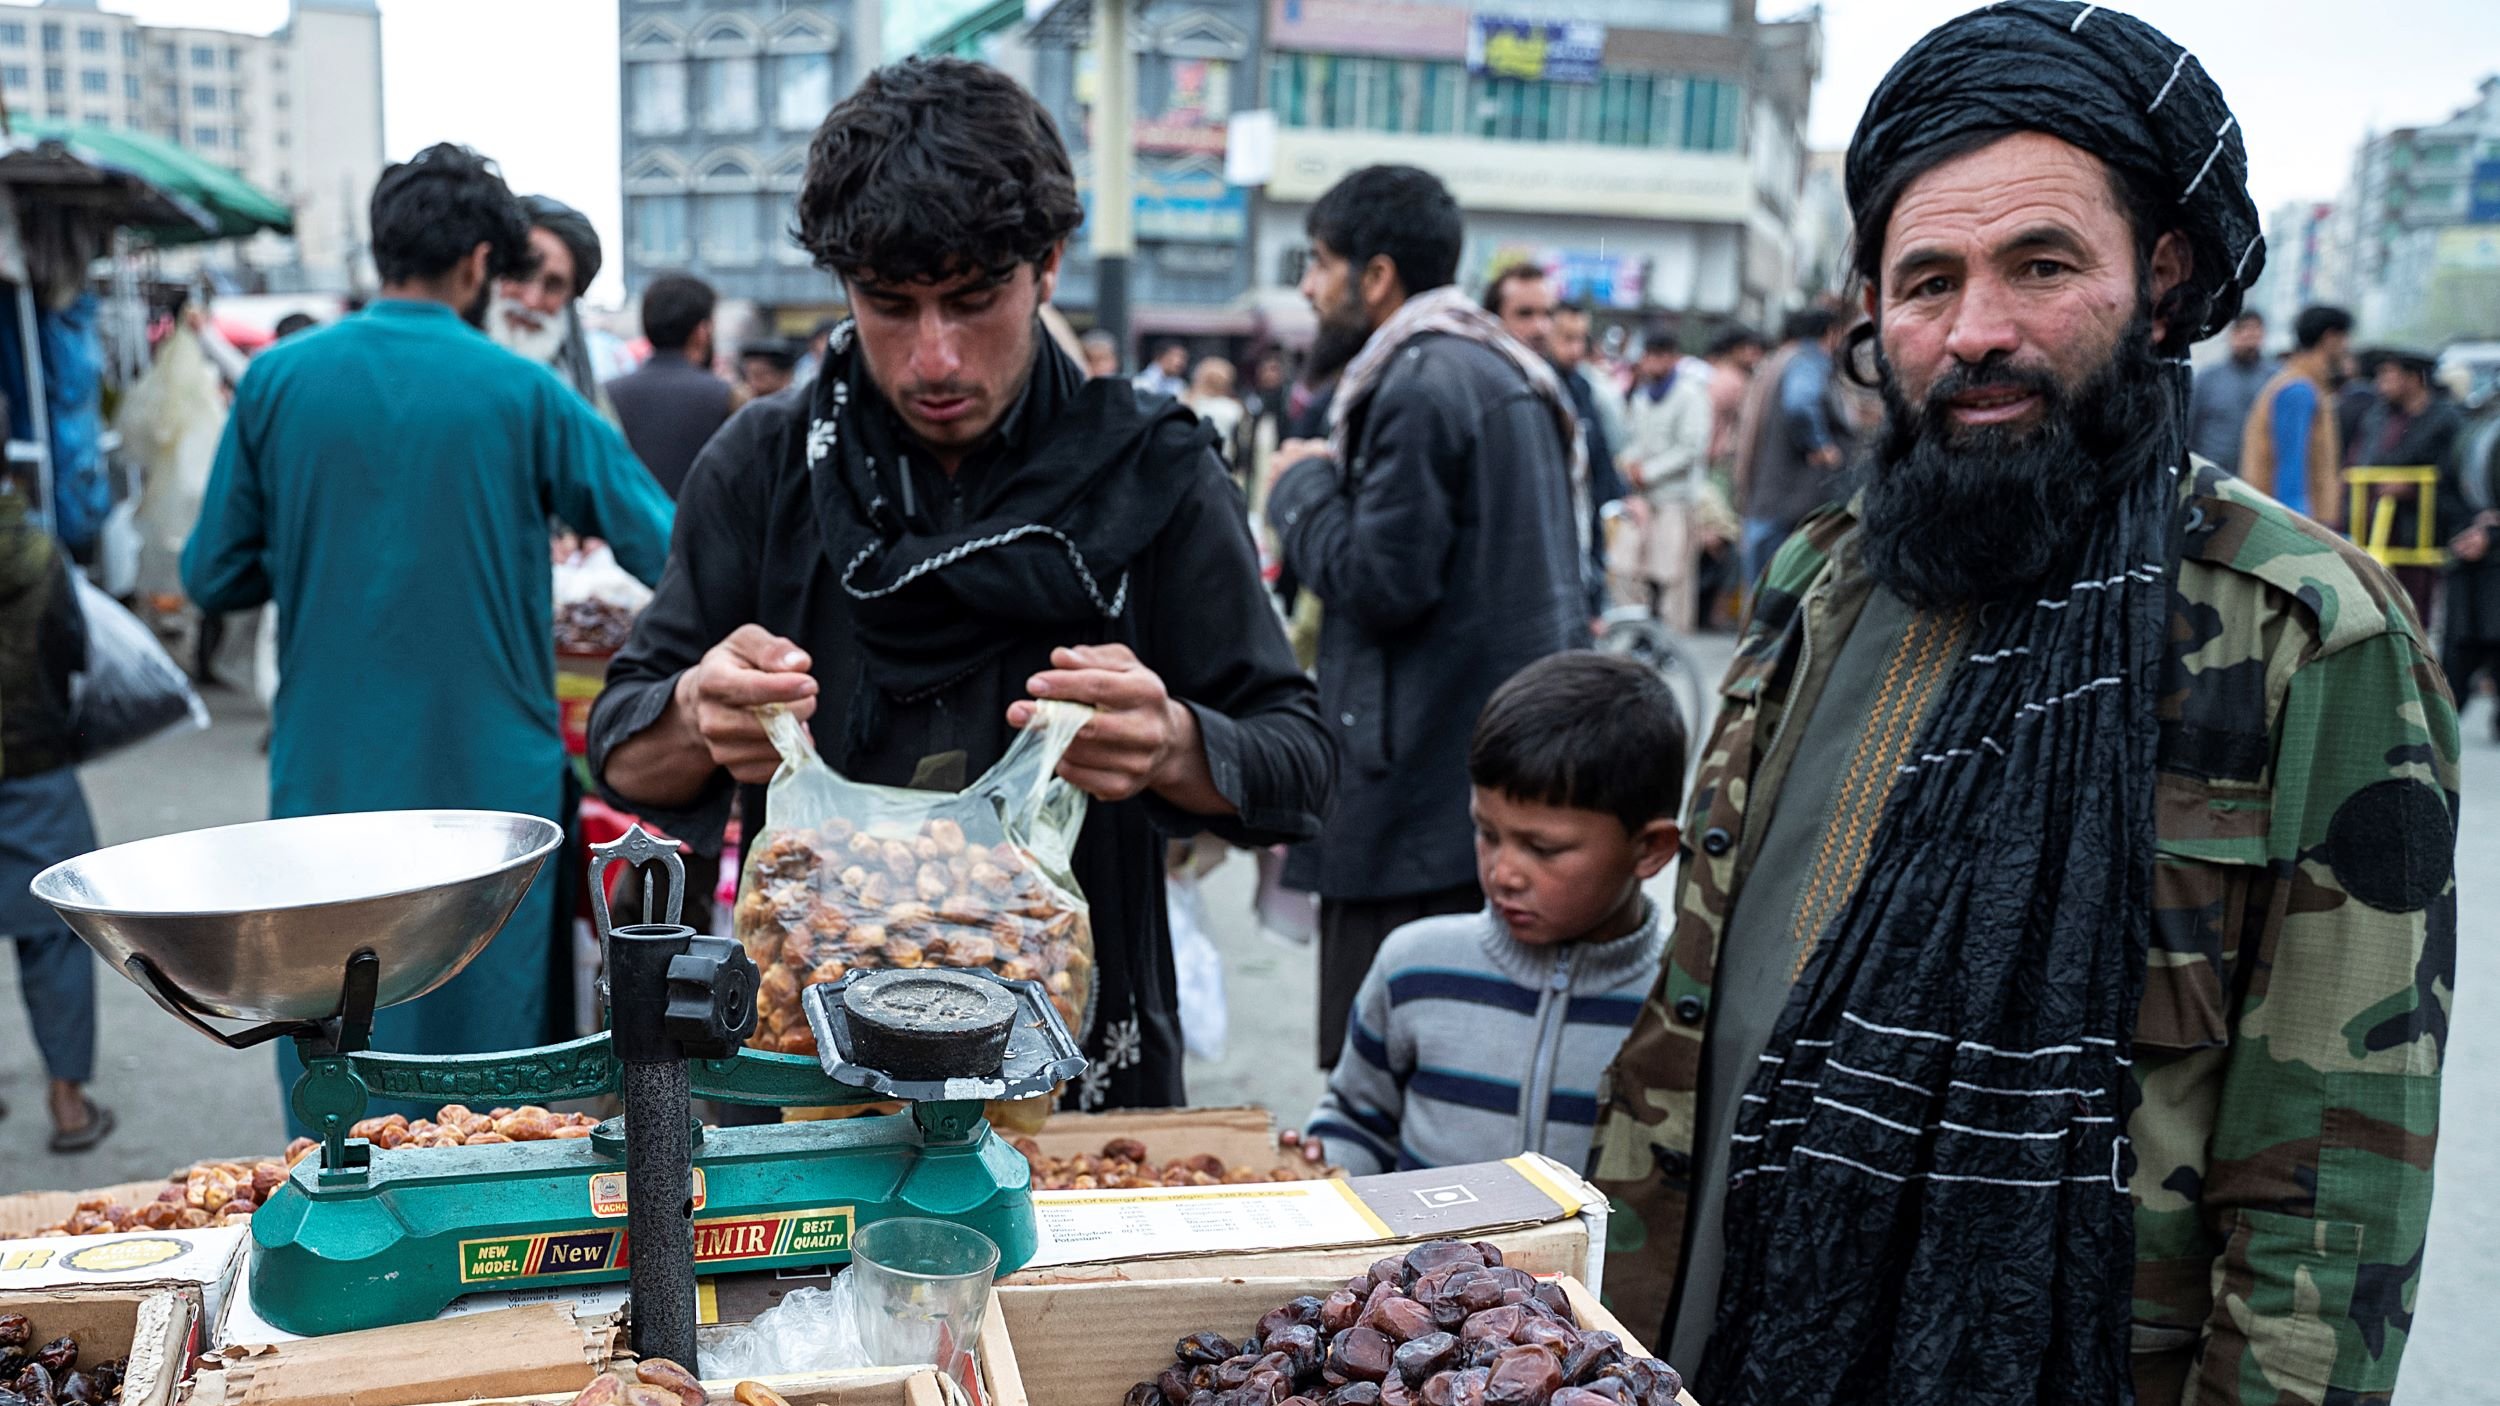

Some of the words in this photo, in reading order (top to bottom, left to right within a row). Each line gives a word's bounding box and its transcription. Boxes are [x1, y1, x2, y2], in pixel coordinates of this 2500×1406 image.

[598, 1203, 628, 1213] KACHA
[802, 1220, 835, 1234] BEST
[694, 1224, 766, 1257] HMIR
[793, 1234, 844, 1250] QUALITY
[0, 1249, 56, 1271] R
[478, 1246, 509, 1260] NEW
[550, 1244, 603, 1264] New
[471, 1260, 519, 1275] MODEL
[508, 1294, 545, 1303] Vitamin
